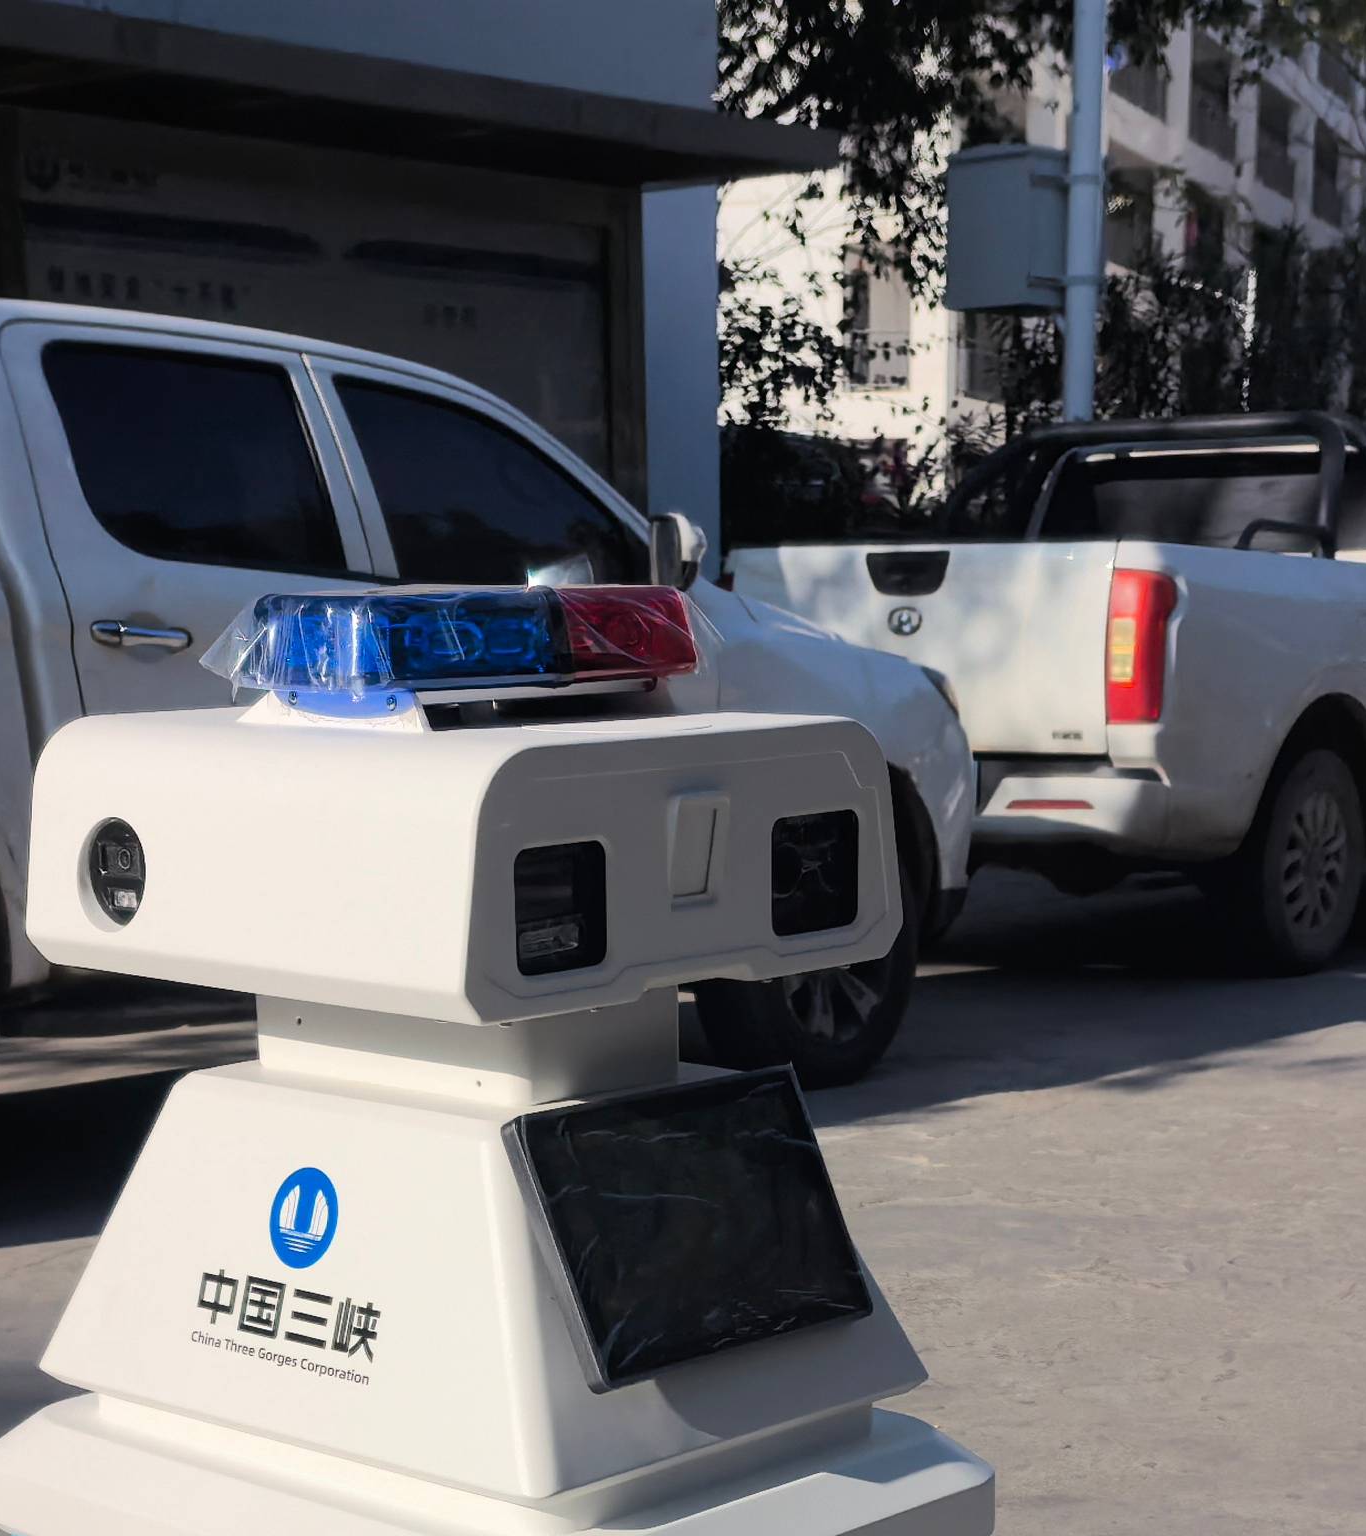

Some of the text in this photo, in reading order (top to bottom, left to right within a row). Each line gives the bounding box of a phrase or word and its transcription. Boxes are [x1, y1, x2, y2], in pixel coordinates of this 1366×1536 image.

[197, 1269, 381, 1363] 中国三峡
[191, 1330, 370, 1385] China Three Gorges Corporation
